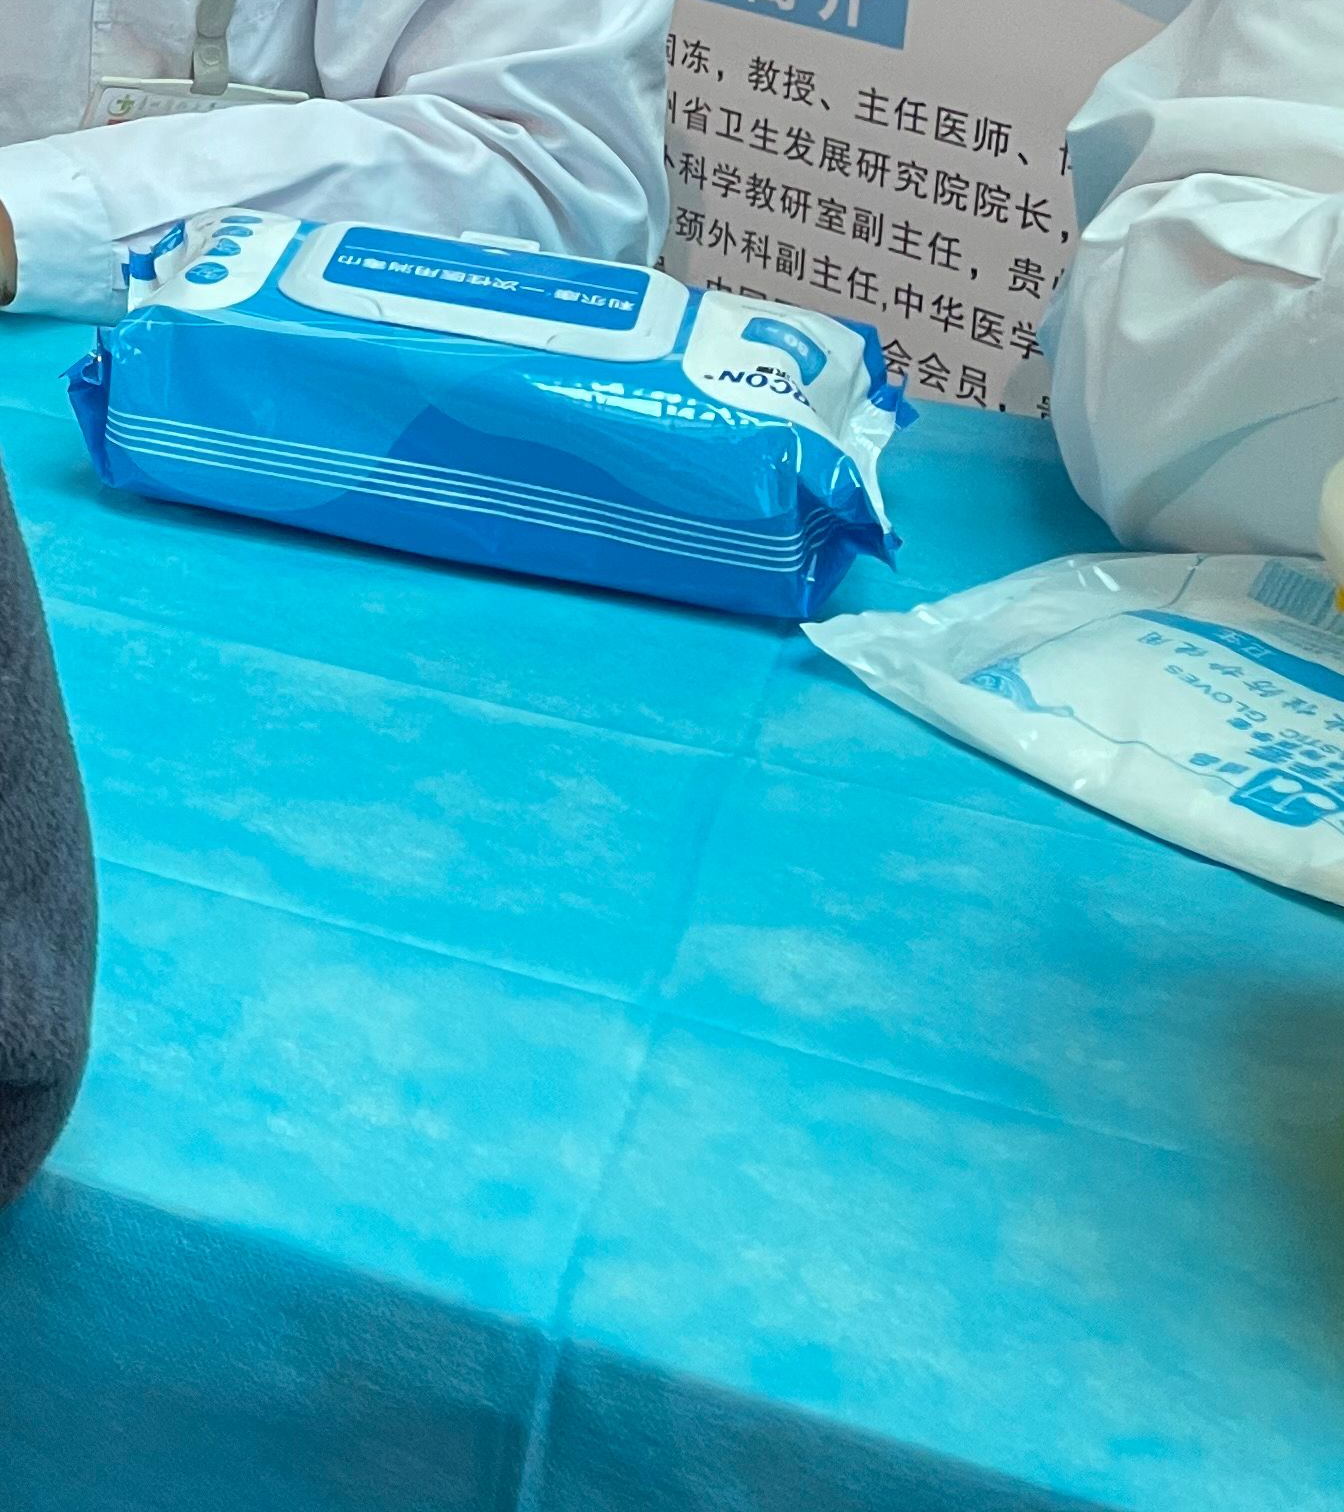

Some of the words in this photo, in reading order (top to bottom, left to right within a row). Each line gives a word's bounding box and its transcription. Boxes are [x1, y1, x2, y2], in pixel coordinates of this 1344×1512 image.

[662, 142, 1065, 300] 科学教研室副主任，贵
[1164, 662, 1268, 724] GLOVES
